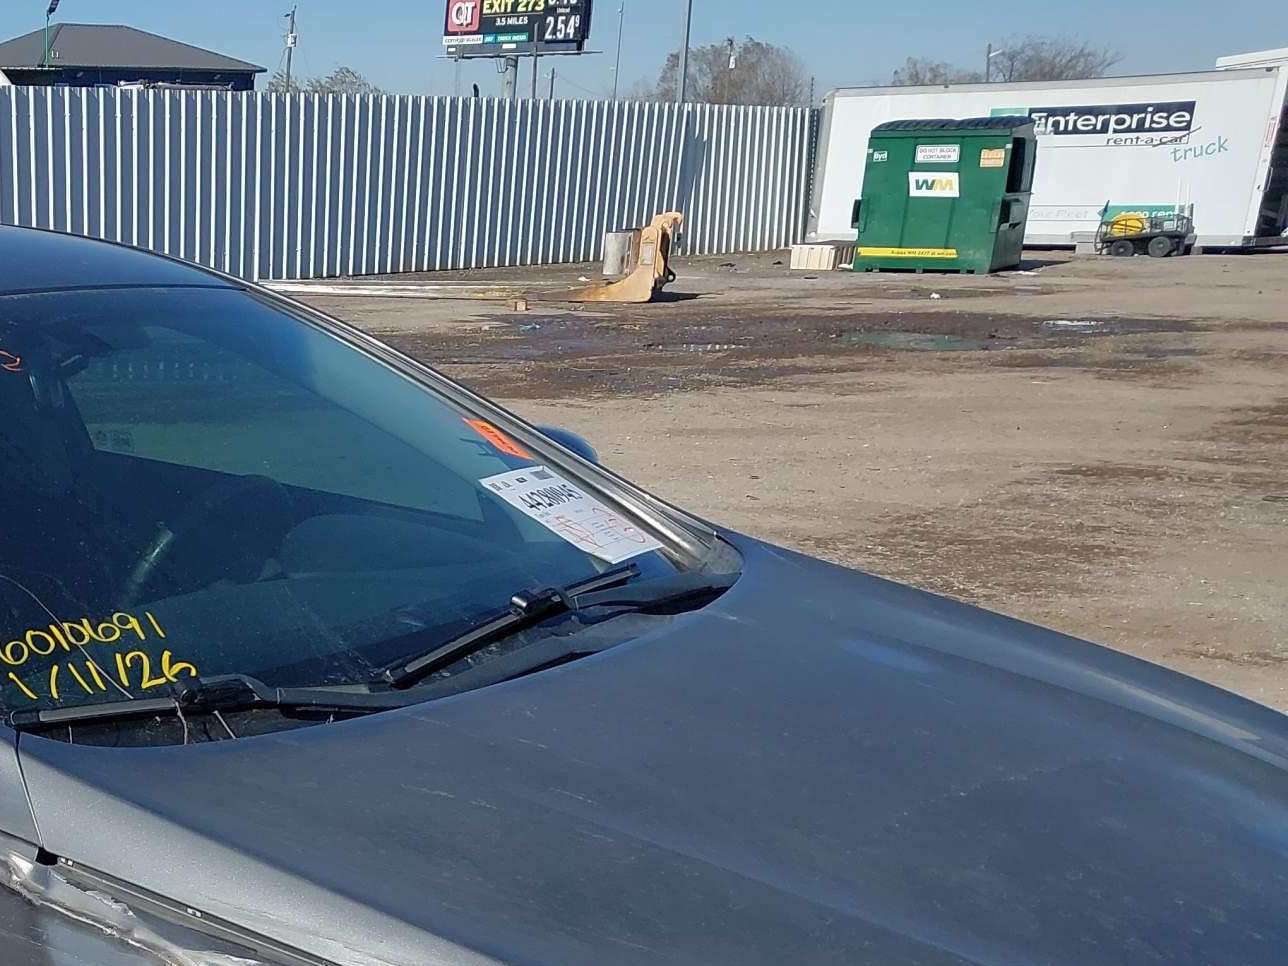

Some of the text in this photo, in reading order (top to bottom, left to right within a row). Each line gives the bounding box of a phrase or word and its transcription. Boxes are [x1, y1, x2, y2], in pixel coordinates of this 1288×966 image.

[452, 2, 475, 26] QT
[483, 0, 545, 14] EXIT 273
[507, 16, 528, 25] MILES
[1171, 136, 1229, 162] truck
[915, 179, 954, 191] WM
